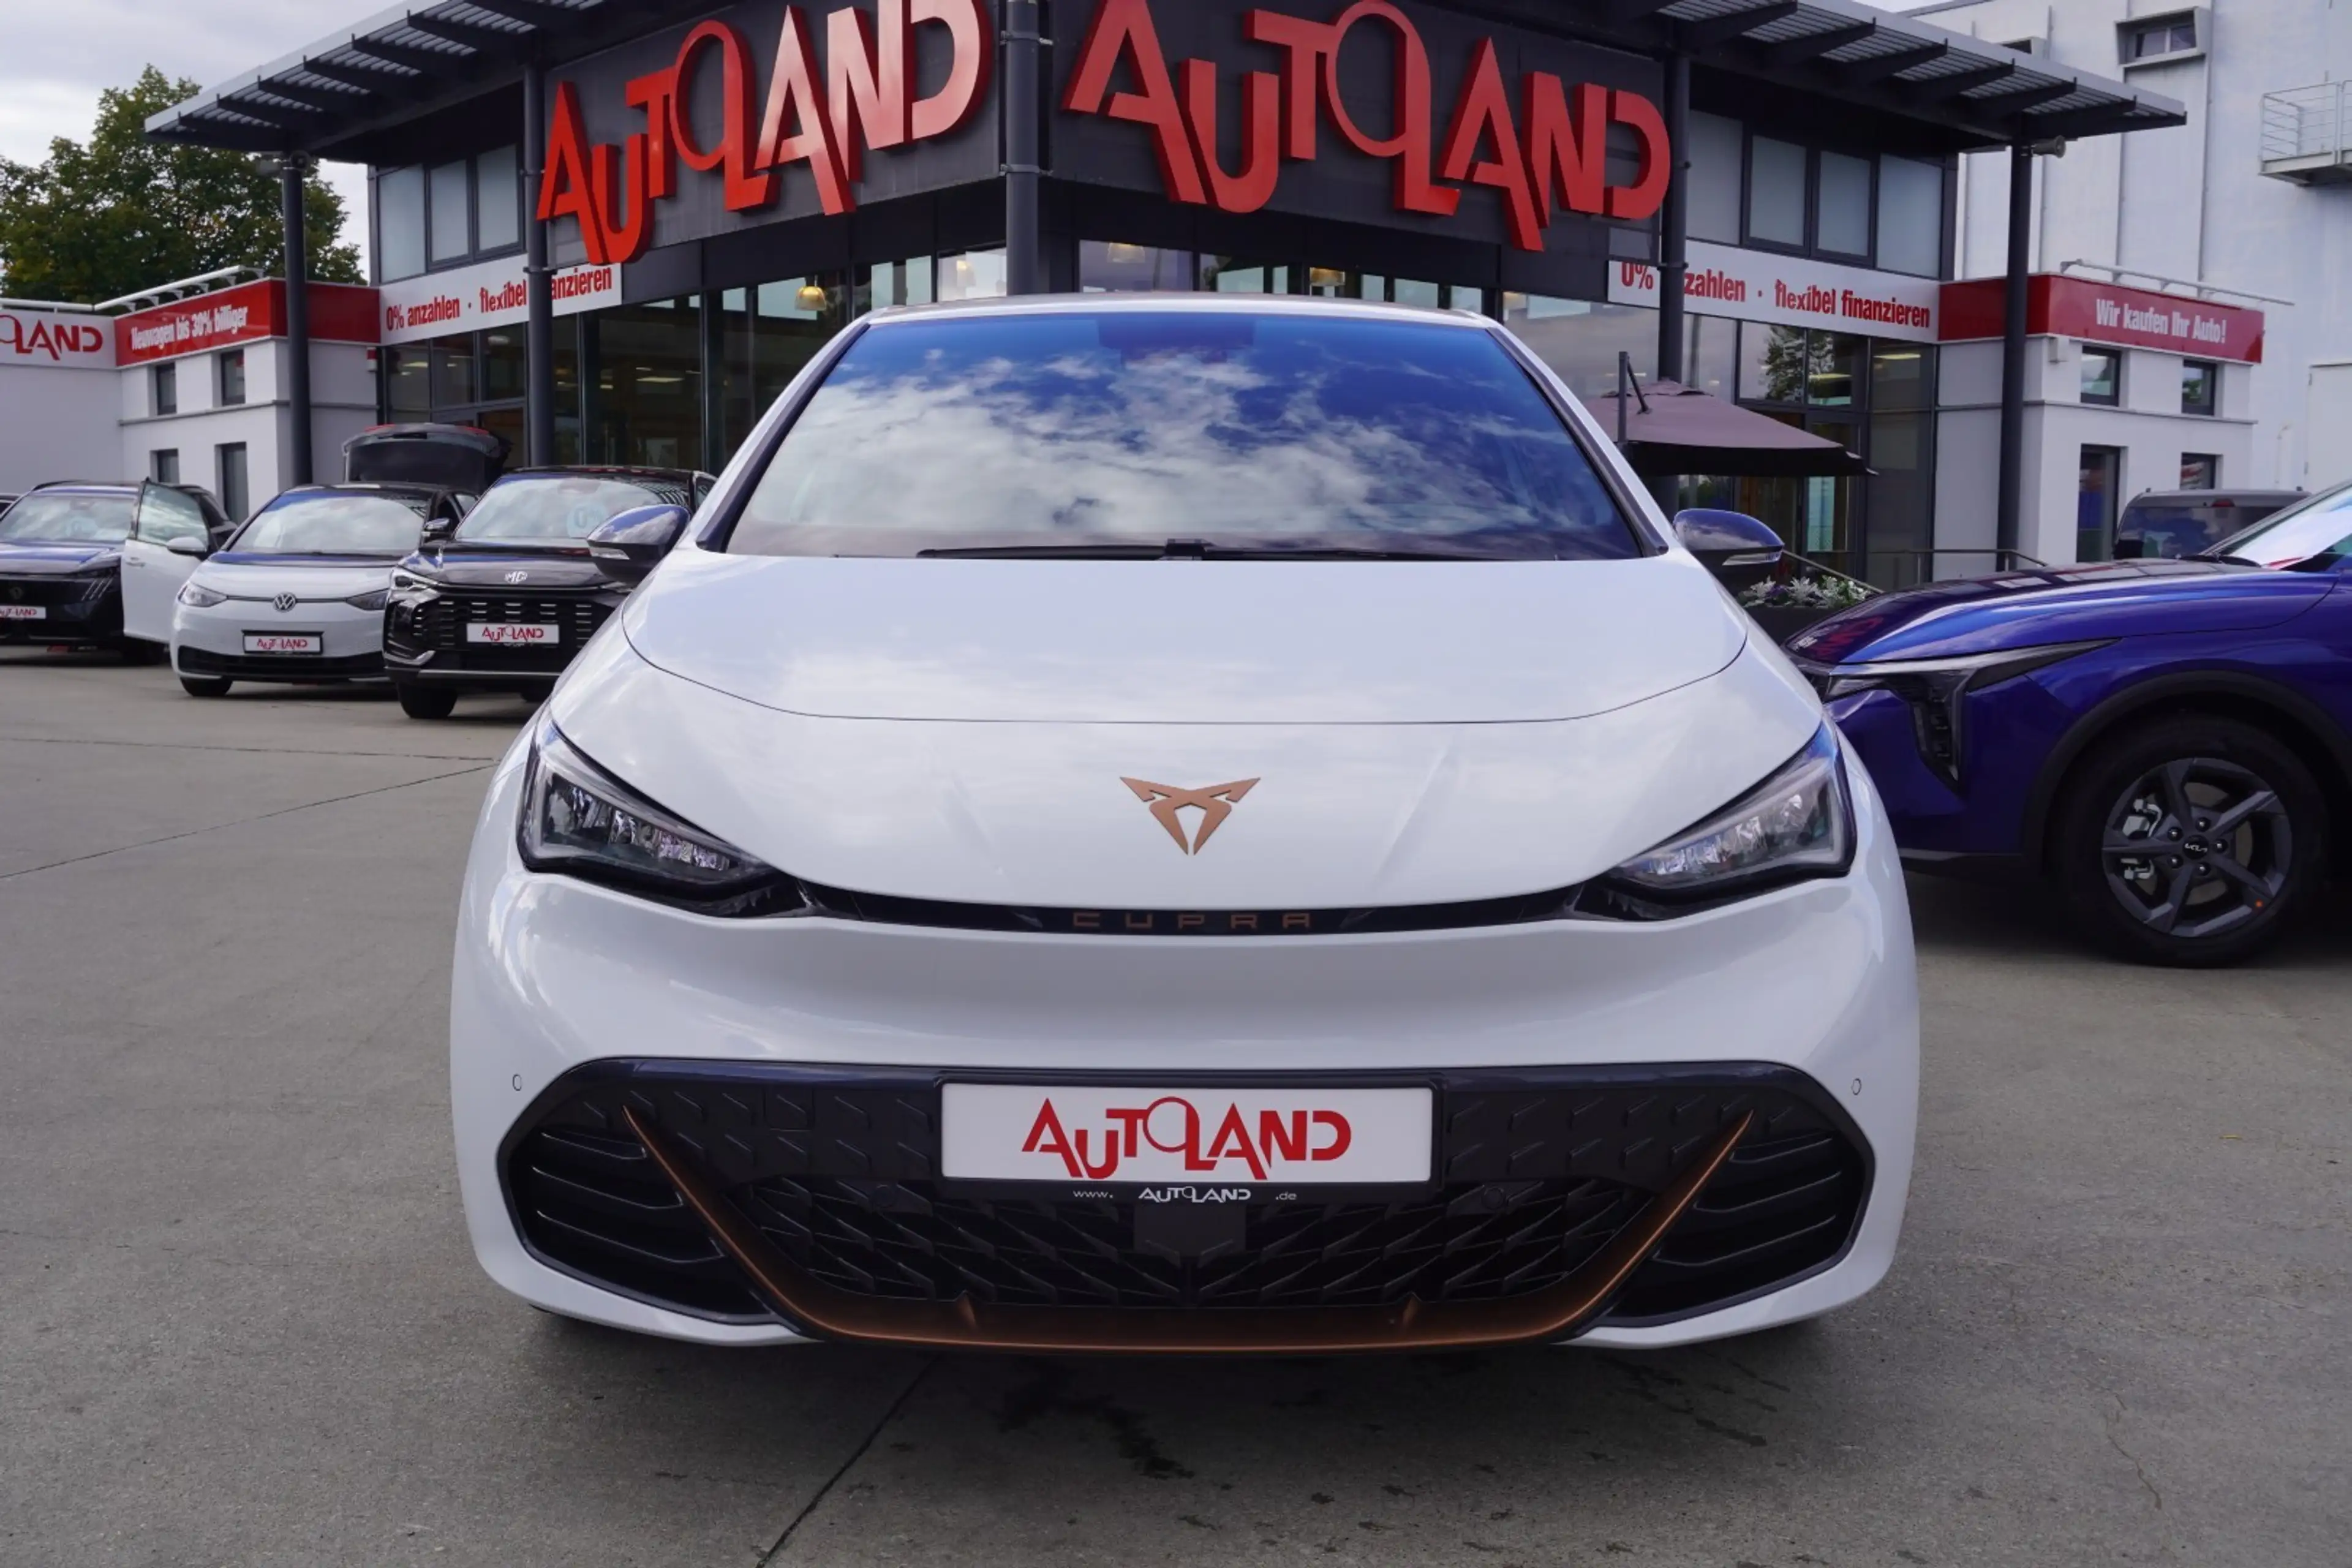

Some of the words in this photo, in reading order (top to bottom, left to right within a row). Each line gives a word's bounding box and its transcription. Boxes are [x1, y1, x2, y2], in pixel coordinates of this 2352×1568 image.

[536, 0, 992, 265] AUTOLAND
[1062, 0, 1671, 252] AUTOLAND
[386, 303, 404, 330] 0%
[408, 295, 460, 326] anzahlen
[480, 279, 526, 313] flexibel
[552, 268, 612, 300] anzieren
[1622, 262, 1653, 290] 0%
[1684, 268, 1745, 302] zahlen
[1775, 279, 1836, 314] flexibel
[1842, 290, 1930, 328] finanzieren
[2097, 298, 2120, 327] Wir
[2124, 303, 2168, 334] kaufen
[2172, 311, 2190, 337] Ihr
[2192, 315, 2226, 343] Auto!
[0, 314, 103, 361] OLAND
[1072, 913, 1310, 929] CUPRA
[1022, 1096, 1351, 1180] AUTOLAND
[1138, 1186, 1251, 1203] AUTOLAND
[1275, 1190, 1297, 1200] .de
